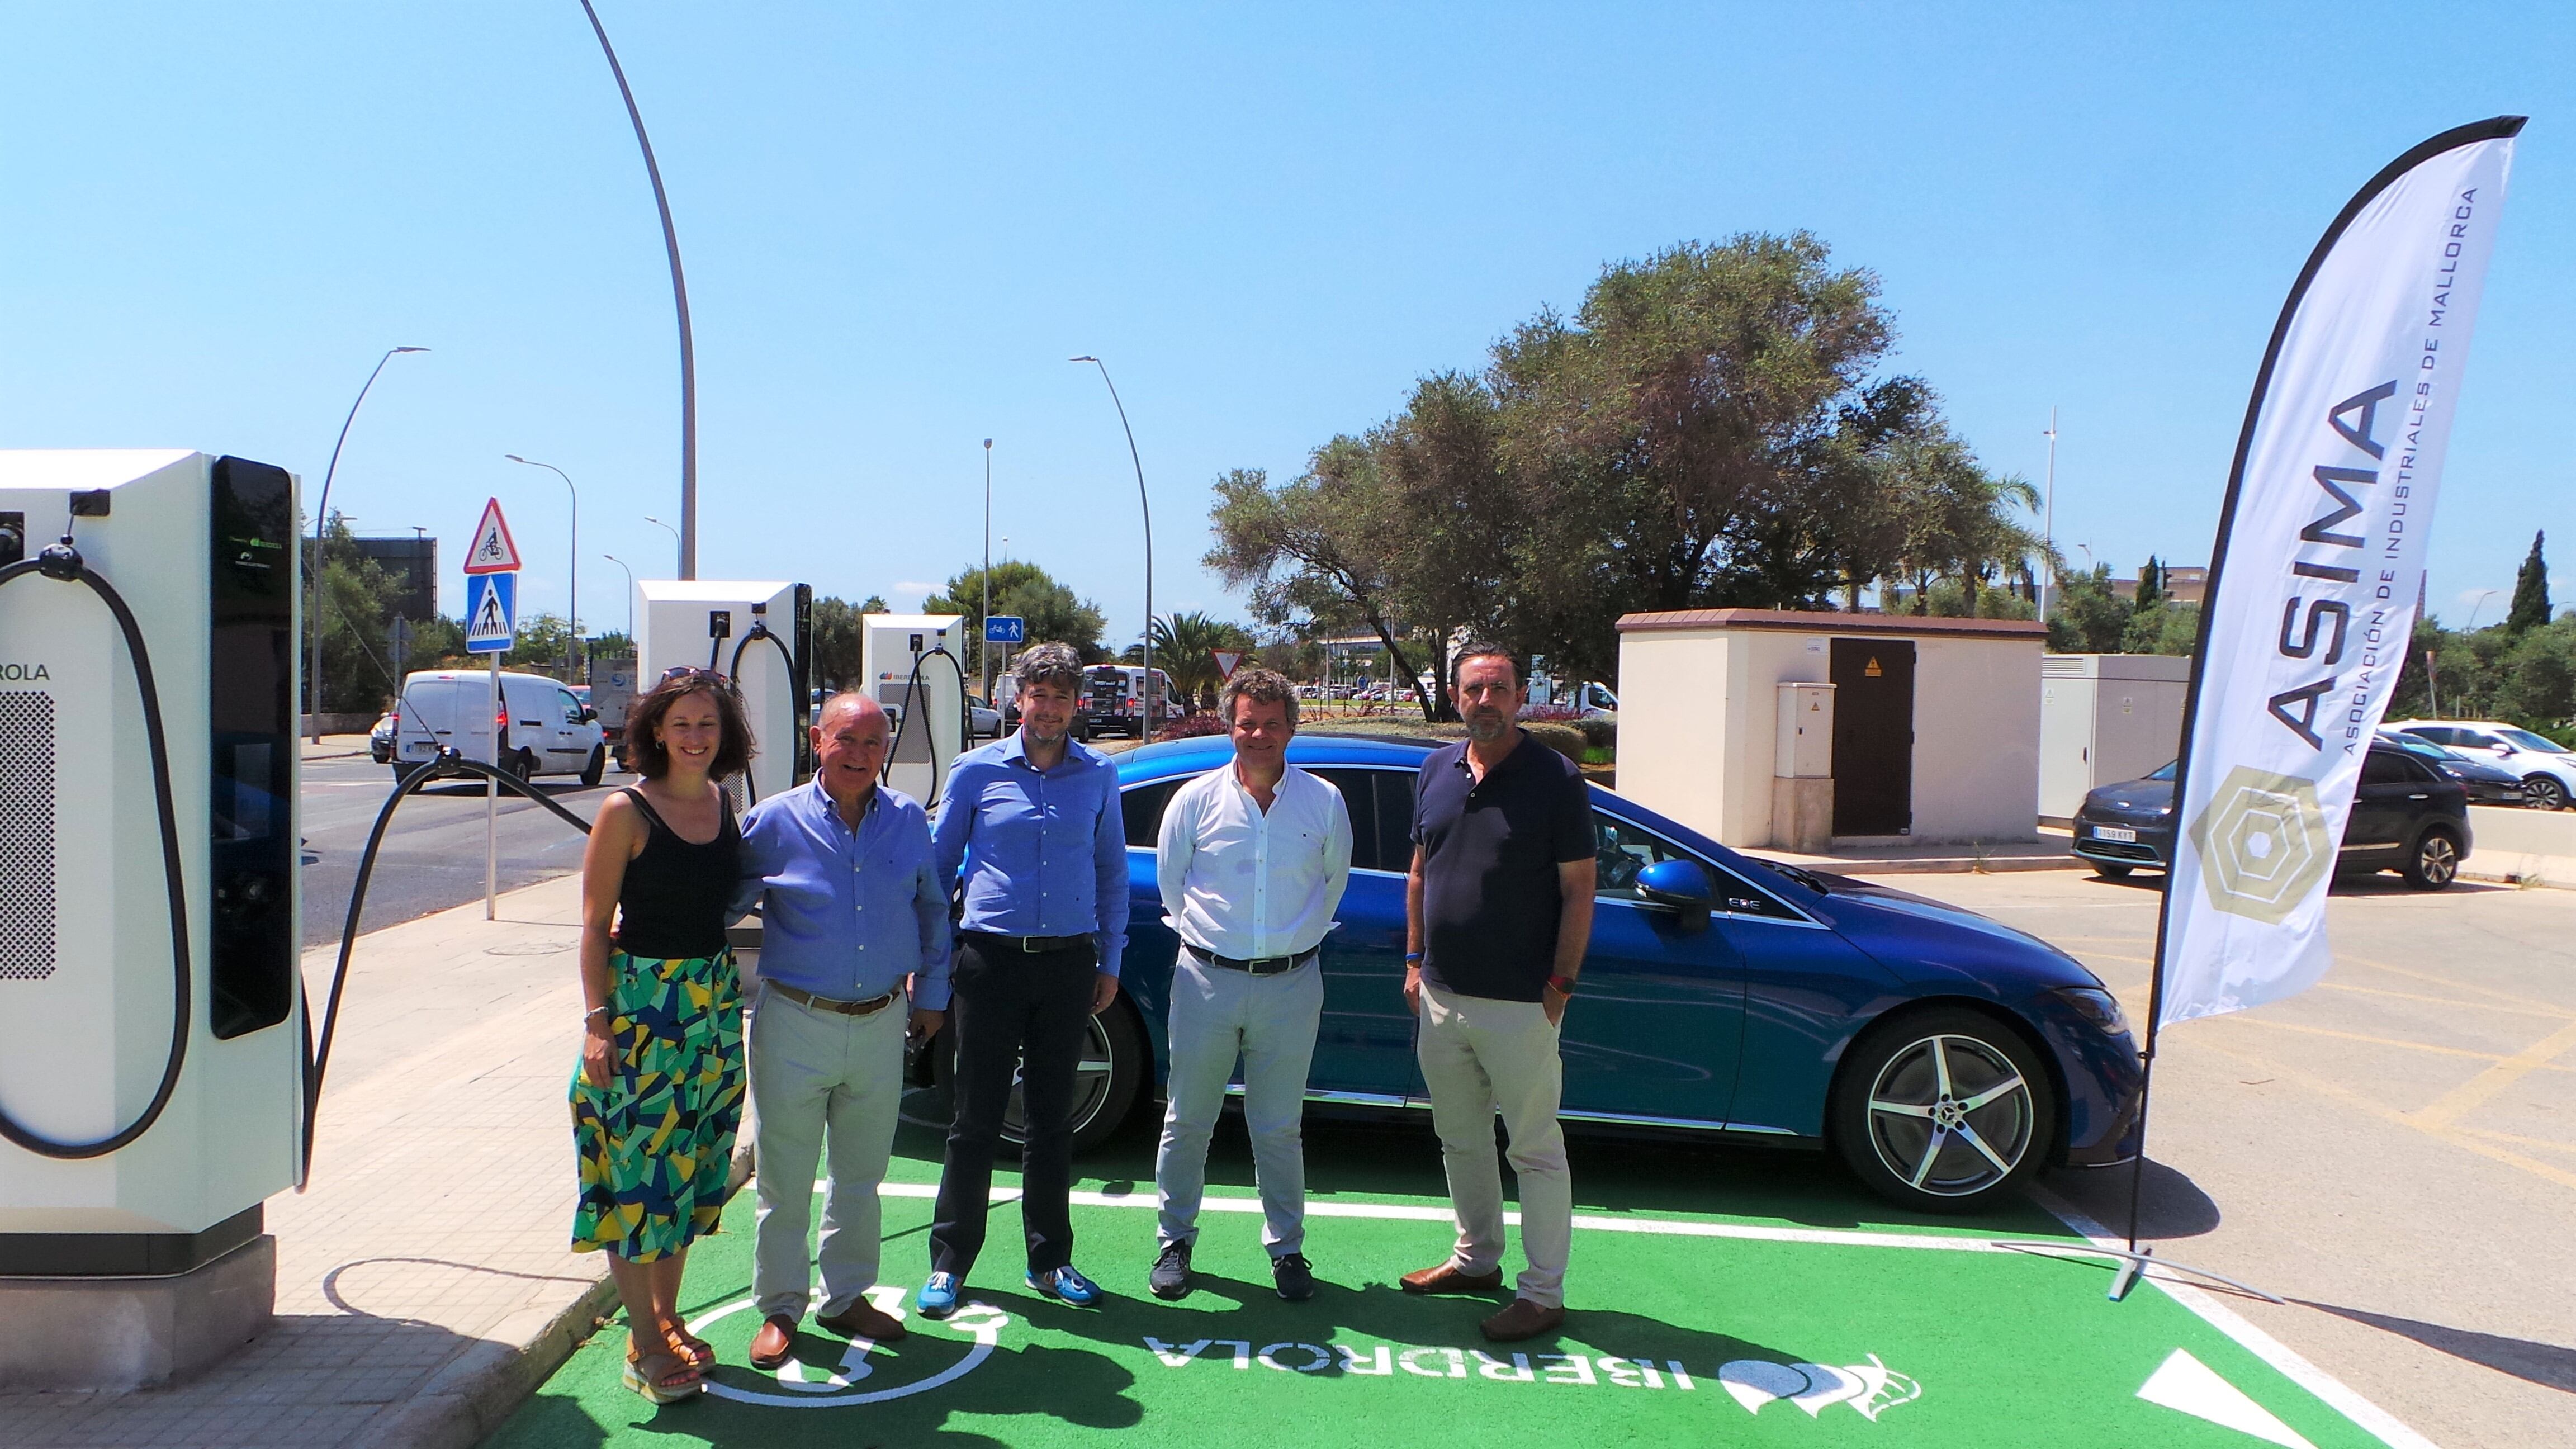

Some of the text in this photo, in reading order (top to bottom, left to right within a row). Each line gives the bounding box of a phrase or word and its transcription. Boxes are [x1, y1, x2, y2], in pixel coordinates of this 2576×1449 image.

[2267, 380, 2397, 751] ASIMA
[2344, 188, 2478, 756] ASOCIACIÓN DE INDUSTRIALES DE MALLORCA
[2099, 828, 2116, 839] 1159
[1142, 1337, 1696, 1390] IBERDROLA
